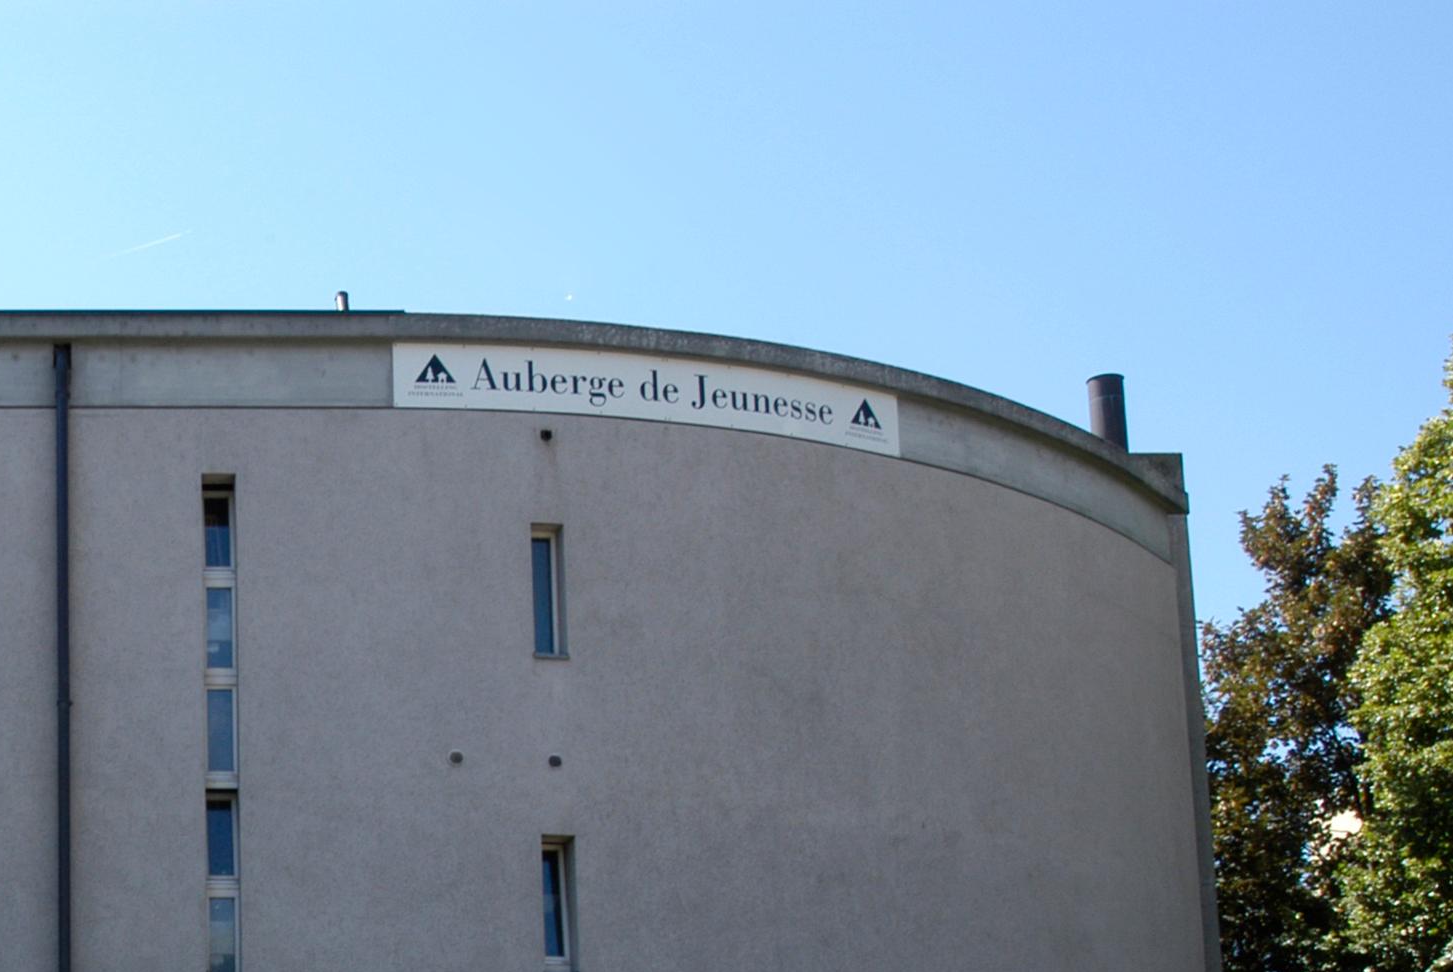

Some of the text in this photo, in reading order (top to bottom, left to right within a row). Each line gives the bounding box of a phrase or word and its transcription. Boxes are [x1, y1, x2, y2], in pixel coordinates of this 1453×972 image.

[470, 357, 834, 426] Auberge de Jeunesse
